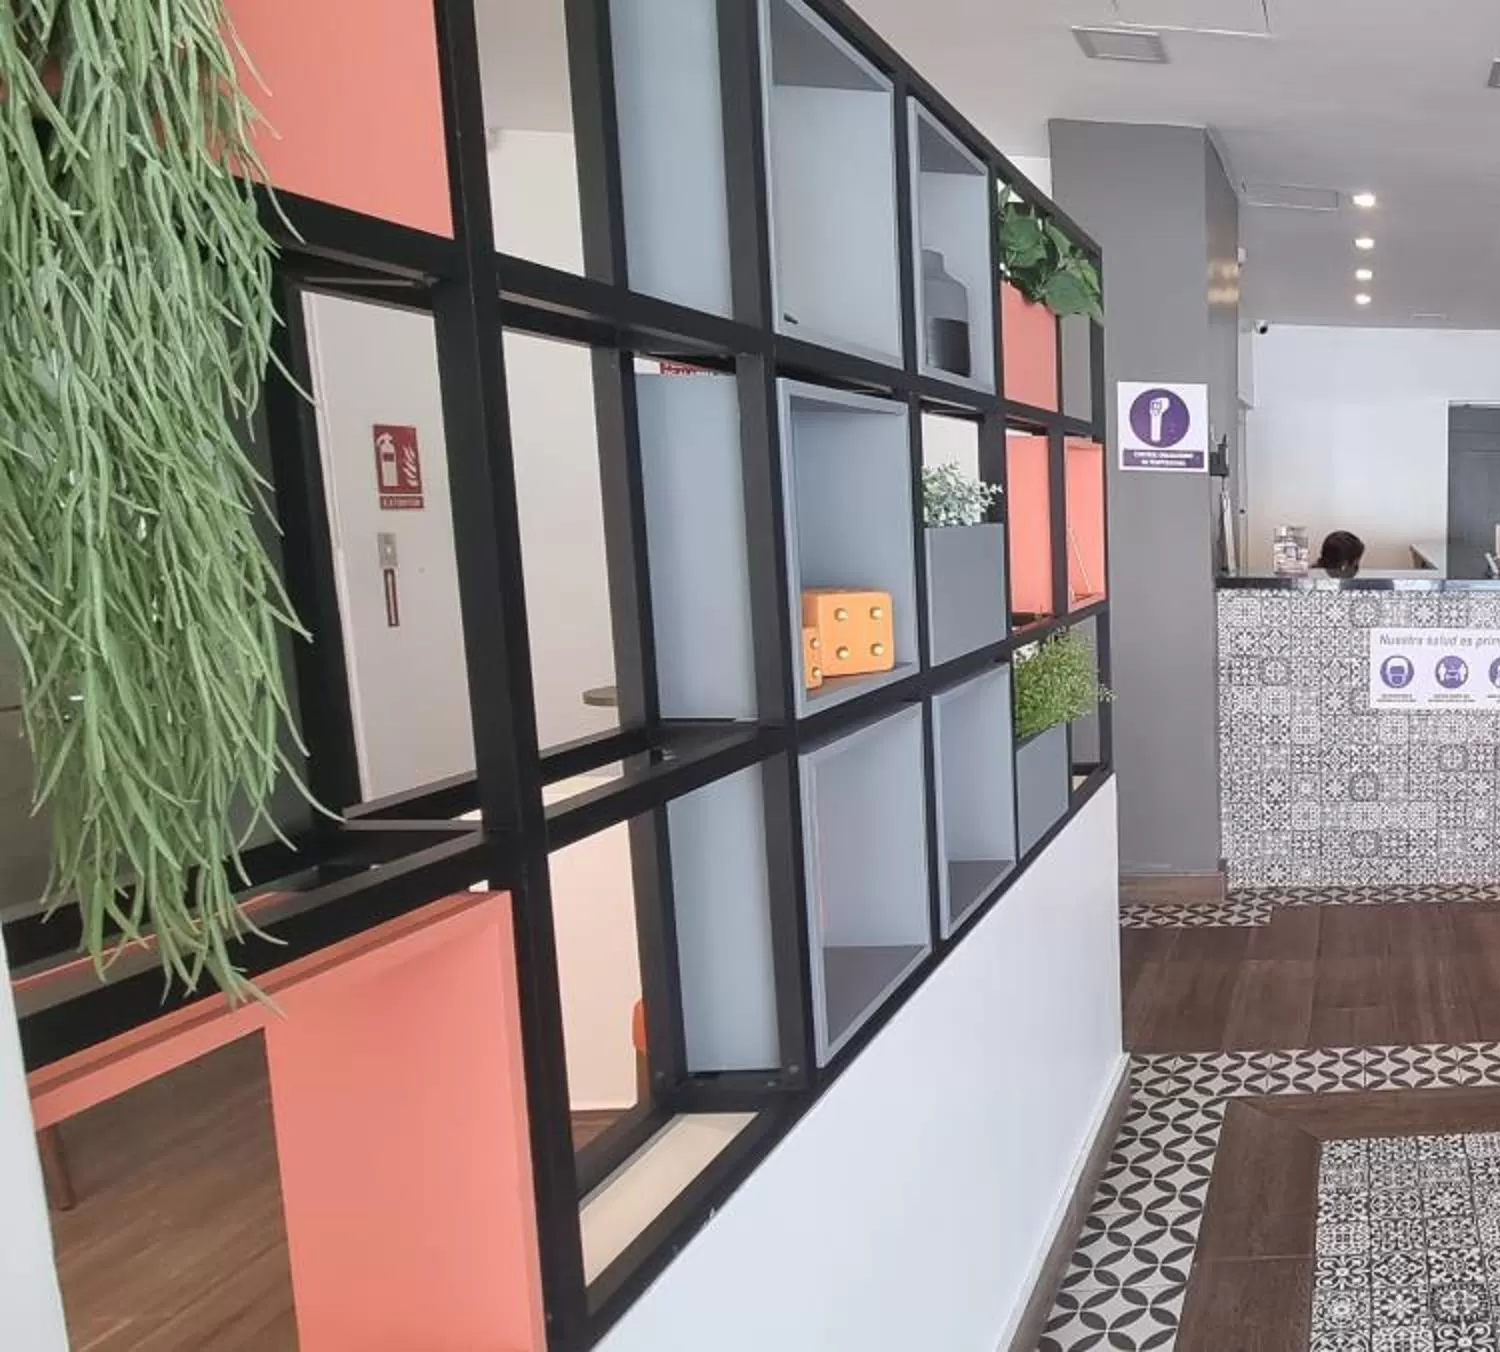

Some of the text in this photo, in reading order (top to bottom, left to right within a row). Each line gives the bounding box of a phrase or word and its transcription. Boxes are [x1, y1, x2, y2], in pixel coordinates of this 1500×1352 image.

[1379, 634, 1423, 646] Nuestra
[1427, 634, 1458, 646] salud
[1460, 637, 1473, 647] es
